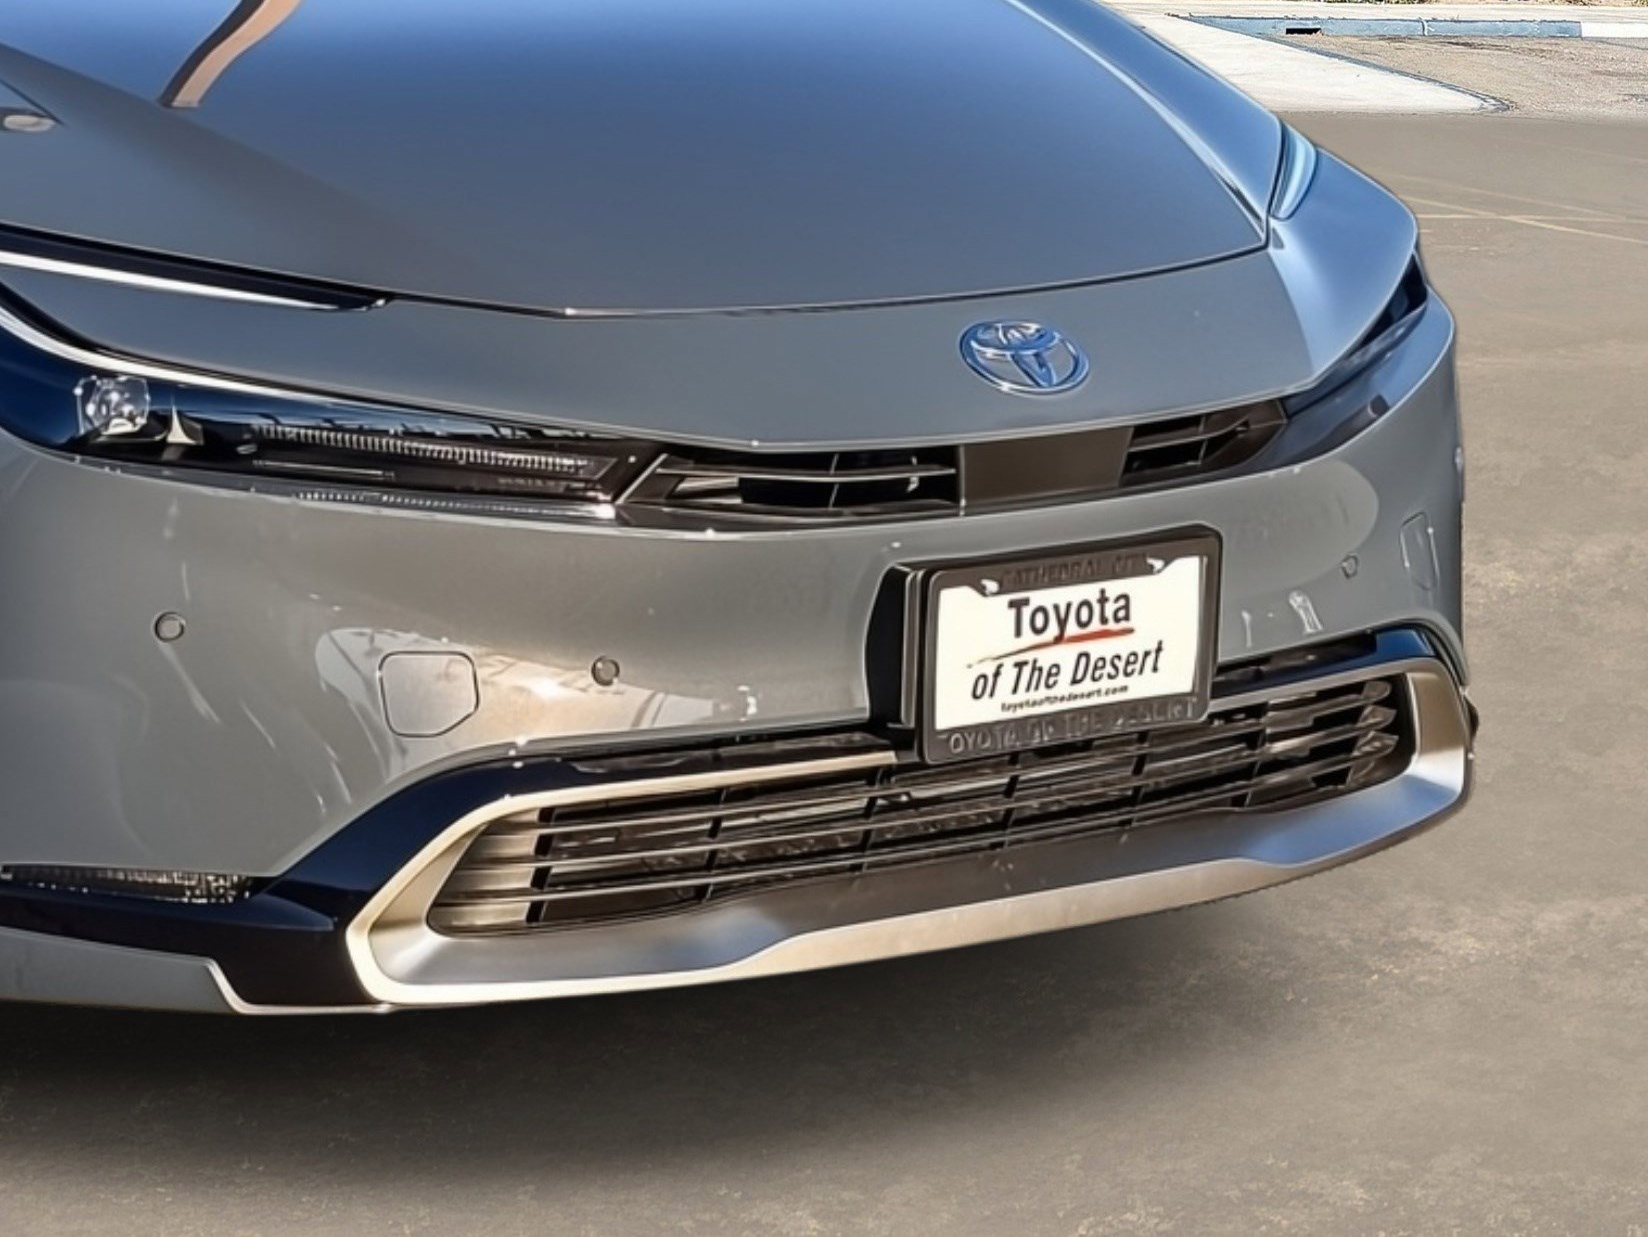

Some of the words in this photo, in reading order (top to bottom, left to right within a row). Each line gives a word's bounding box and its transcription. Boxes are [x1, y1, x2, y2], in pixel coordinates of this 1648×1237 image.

[1007, 588, 1131, 644] Toyota
[971, 663, 1004, 700] of
[1011, 657, 1061, 695] The
[1070, 640, 1163, 686] Desert
